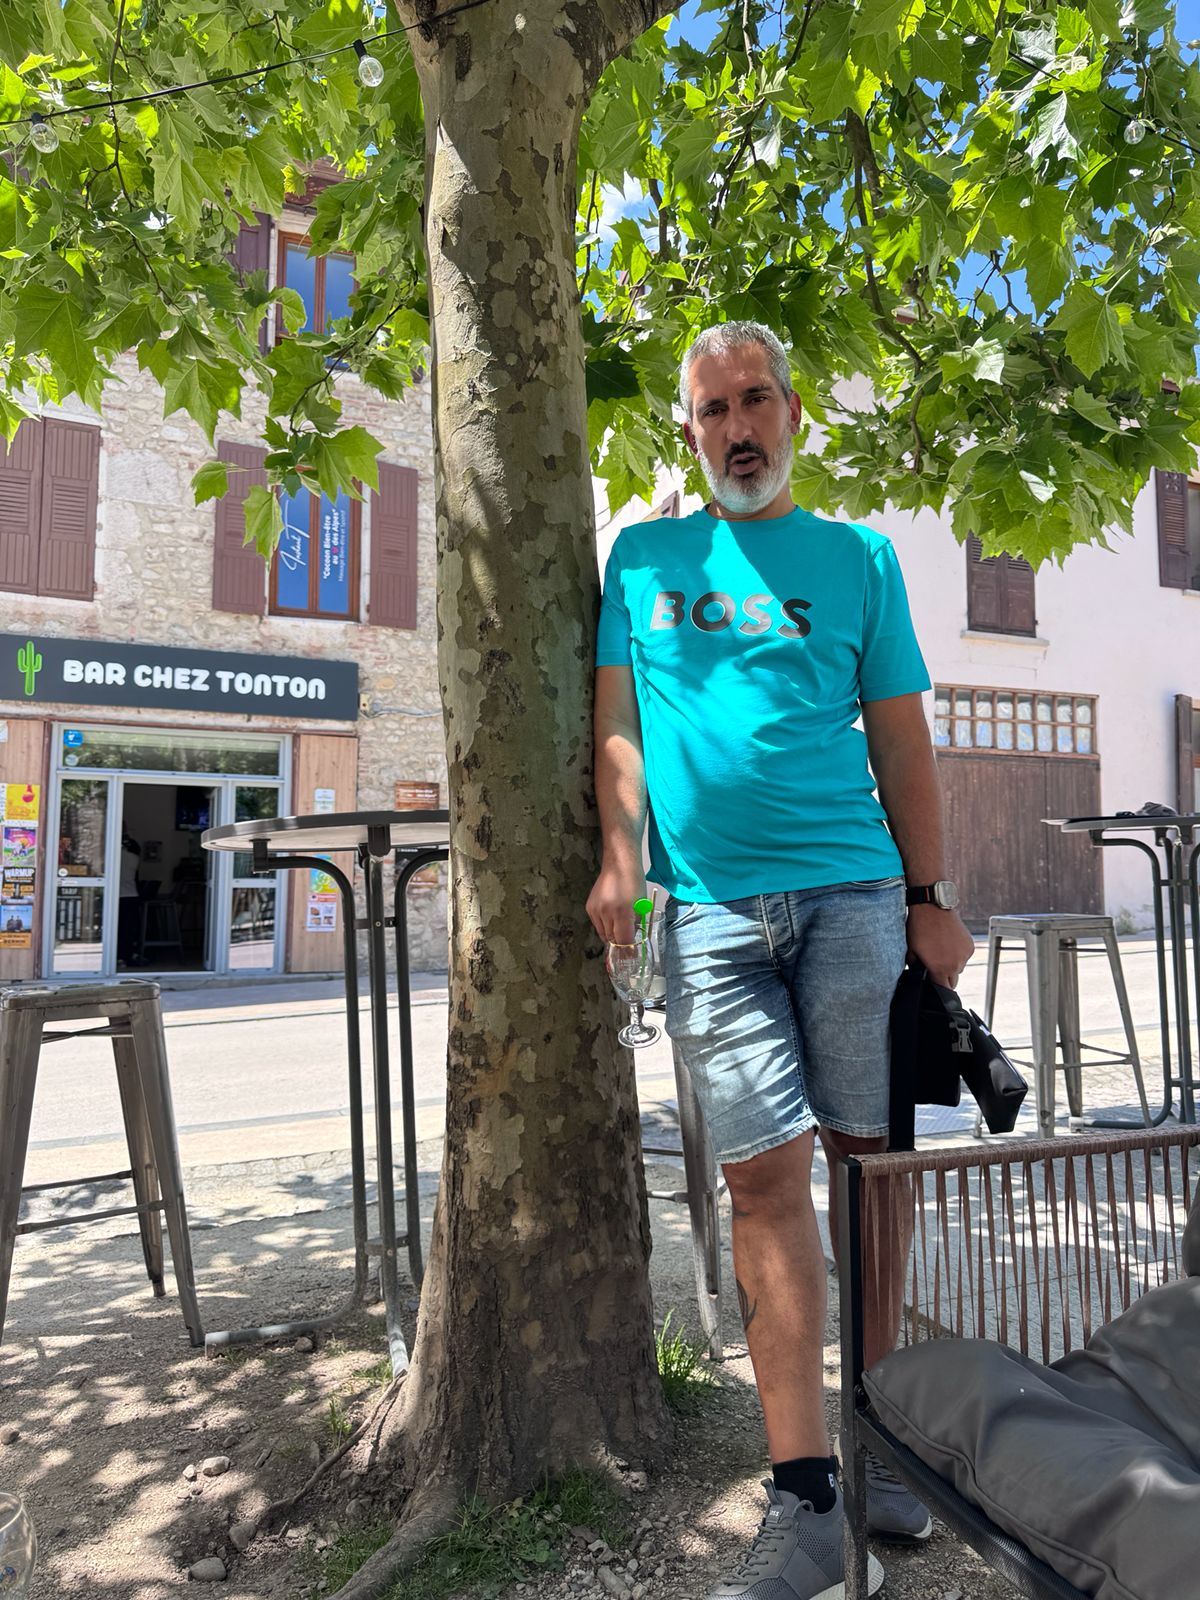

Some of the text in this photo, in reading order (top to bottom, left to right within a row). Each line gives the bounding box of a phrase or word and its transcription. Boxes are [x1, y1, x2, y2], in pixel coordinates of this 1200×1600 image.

[323, 515, 331, 548] Bien-être
[331, 532, 339, 546] des
[332, 555, 339, 565] au
[650, 591, 813, 639] BOSS
[63, 659, 326, 700] BAR CHEZ TONTON
